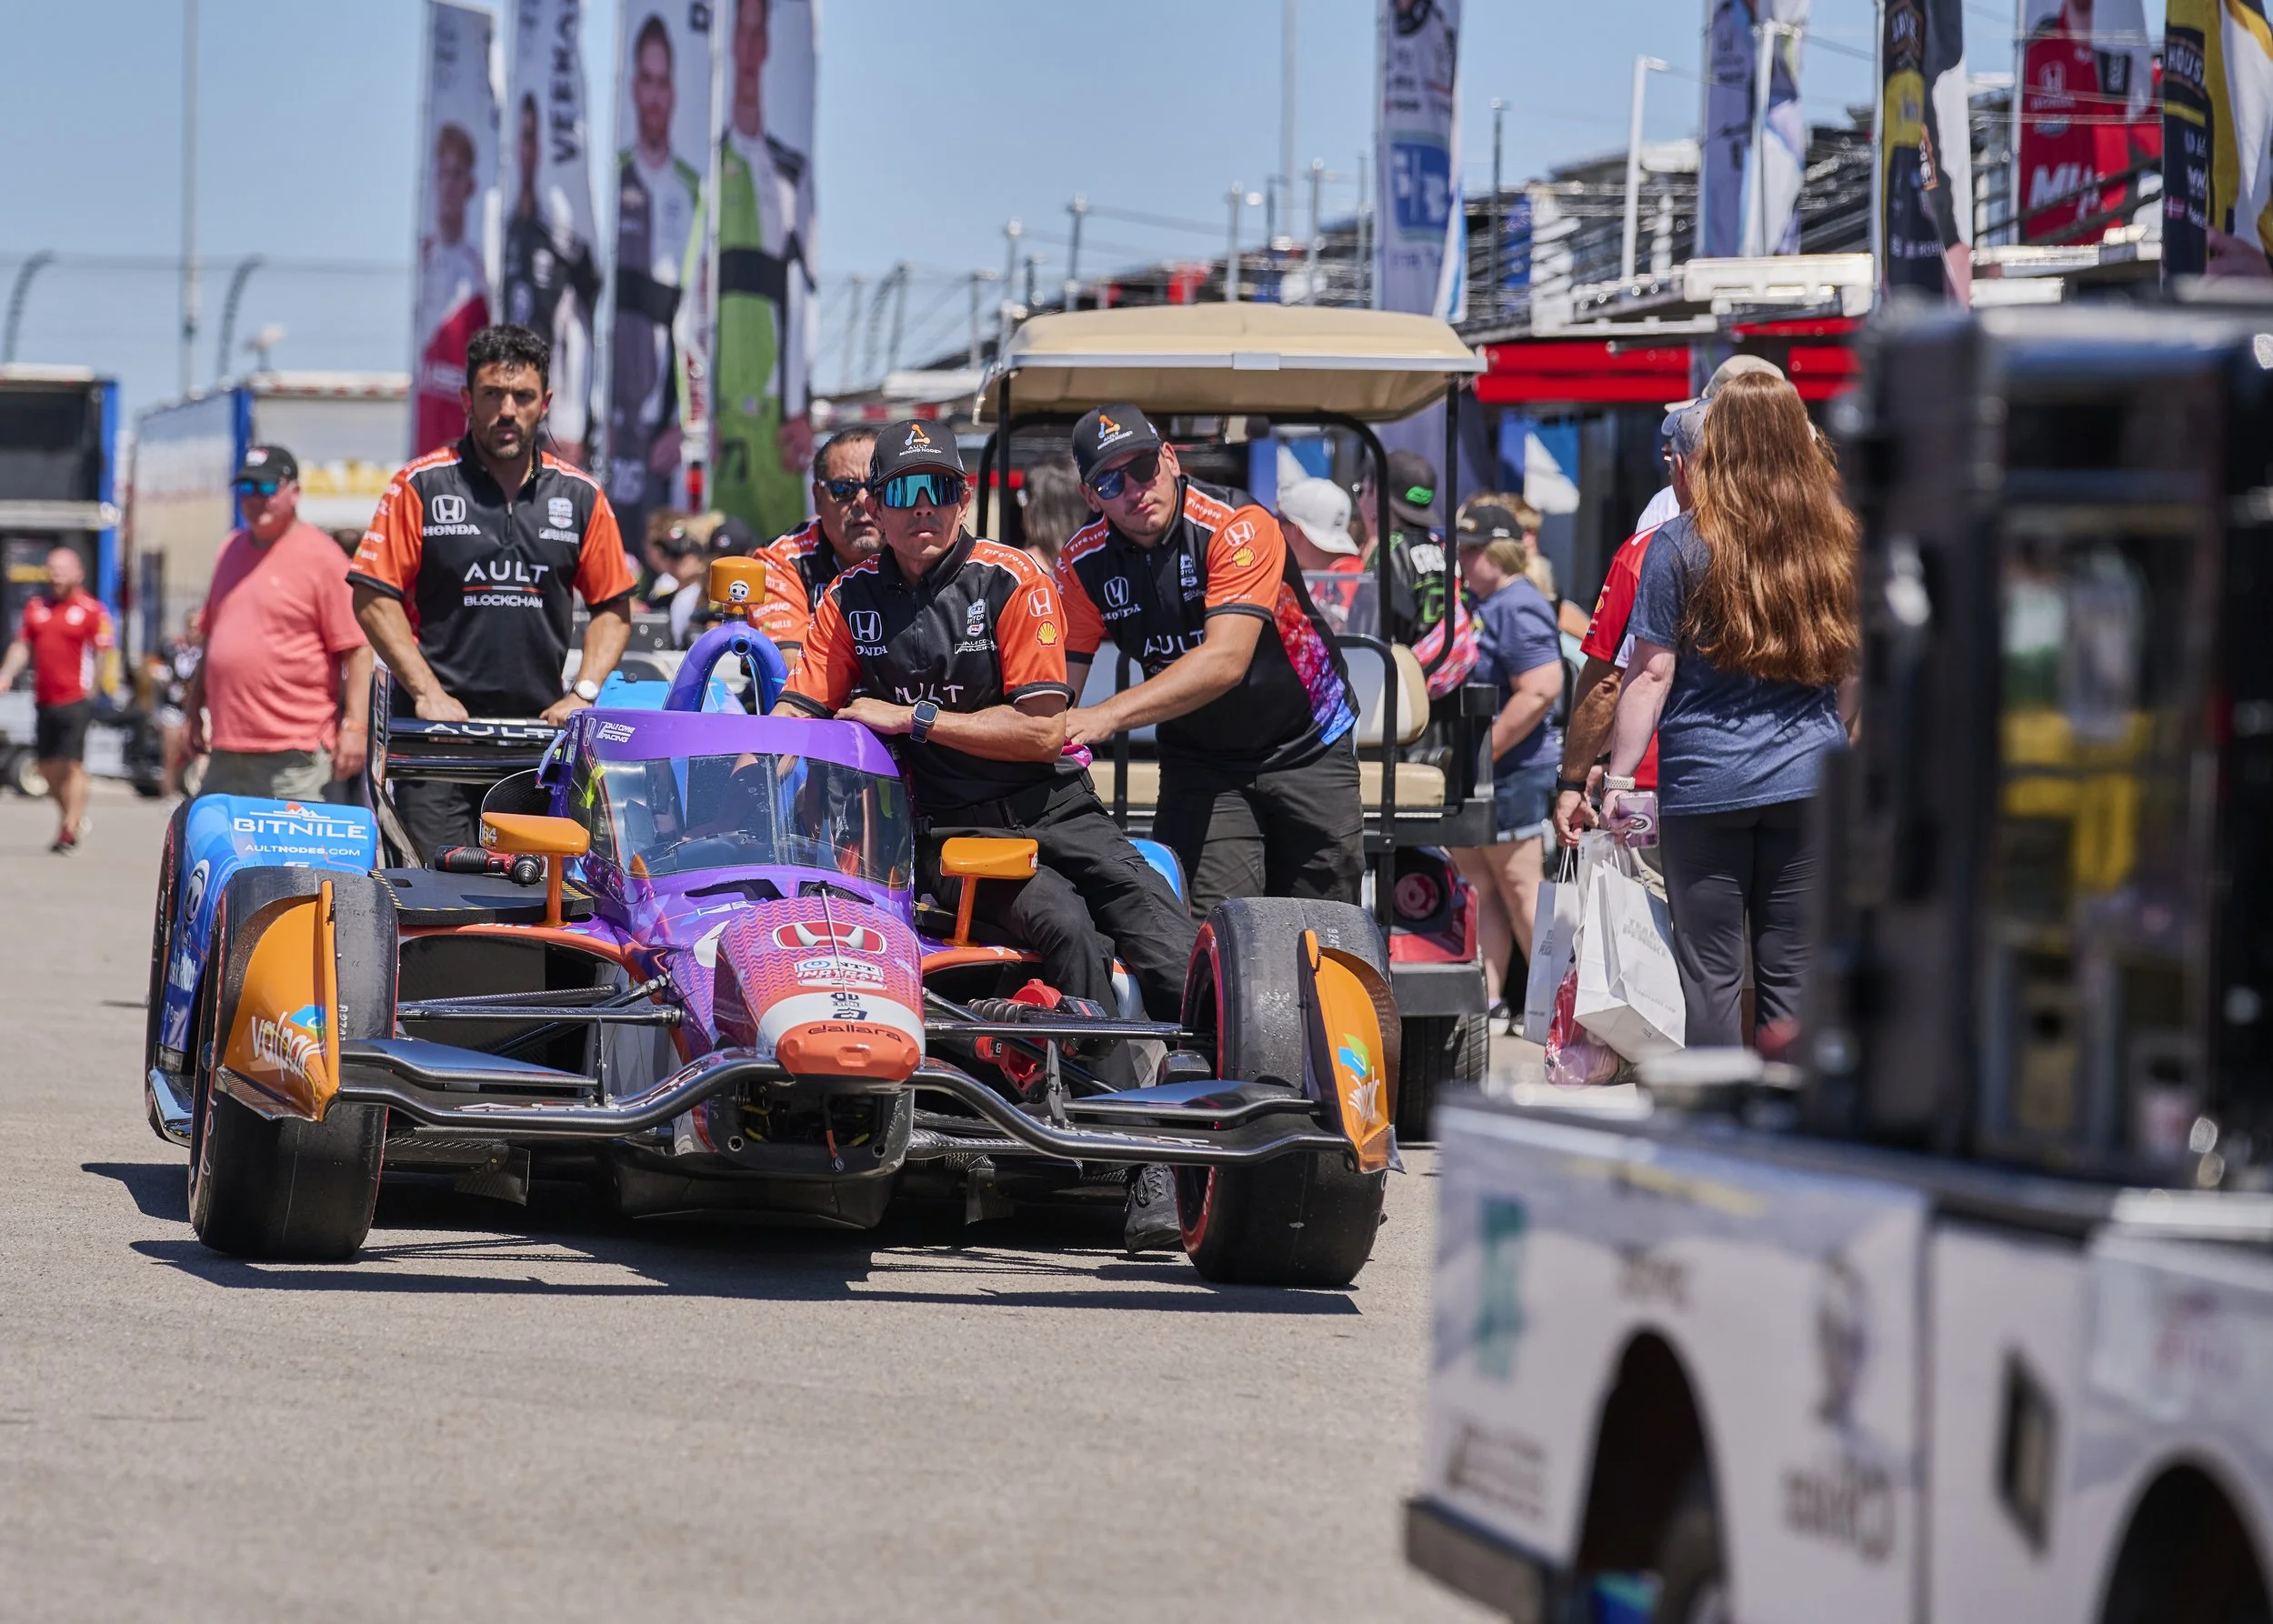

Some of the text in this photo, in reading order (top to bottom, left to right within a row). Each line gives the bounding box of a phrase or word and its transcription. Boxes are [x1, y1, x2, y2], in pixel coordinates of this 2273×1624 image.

[2168, 47, 2204, 85] HOUS
[423, 525, 481, 536] HONDA
[982, 547, 1029, 573] Firestone
[464, 559, 549, 583] AULT
[463, 594, 544, 609] BLOCKCHAN
[855, 645, 888, 657] ONDA
[424, 723, 555, 739] AULT
[602, 734, 629, 743] RACING
[234, 817, 368, 839] BITNILE
[245, 844, 361, 857] AULTNODES.COM
[797, 968, 885, 983] INDYCAR
[807, 1024, 903, 1043] dallara
